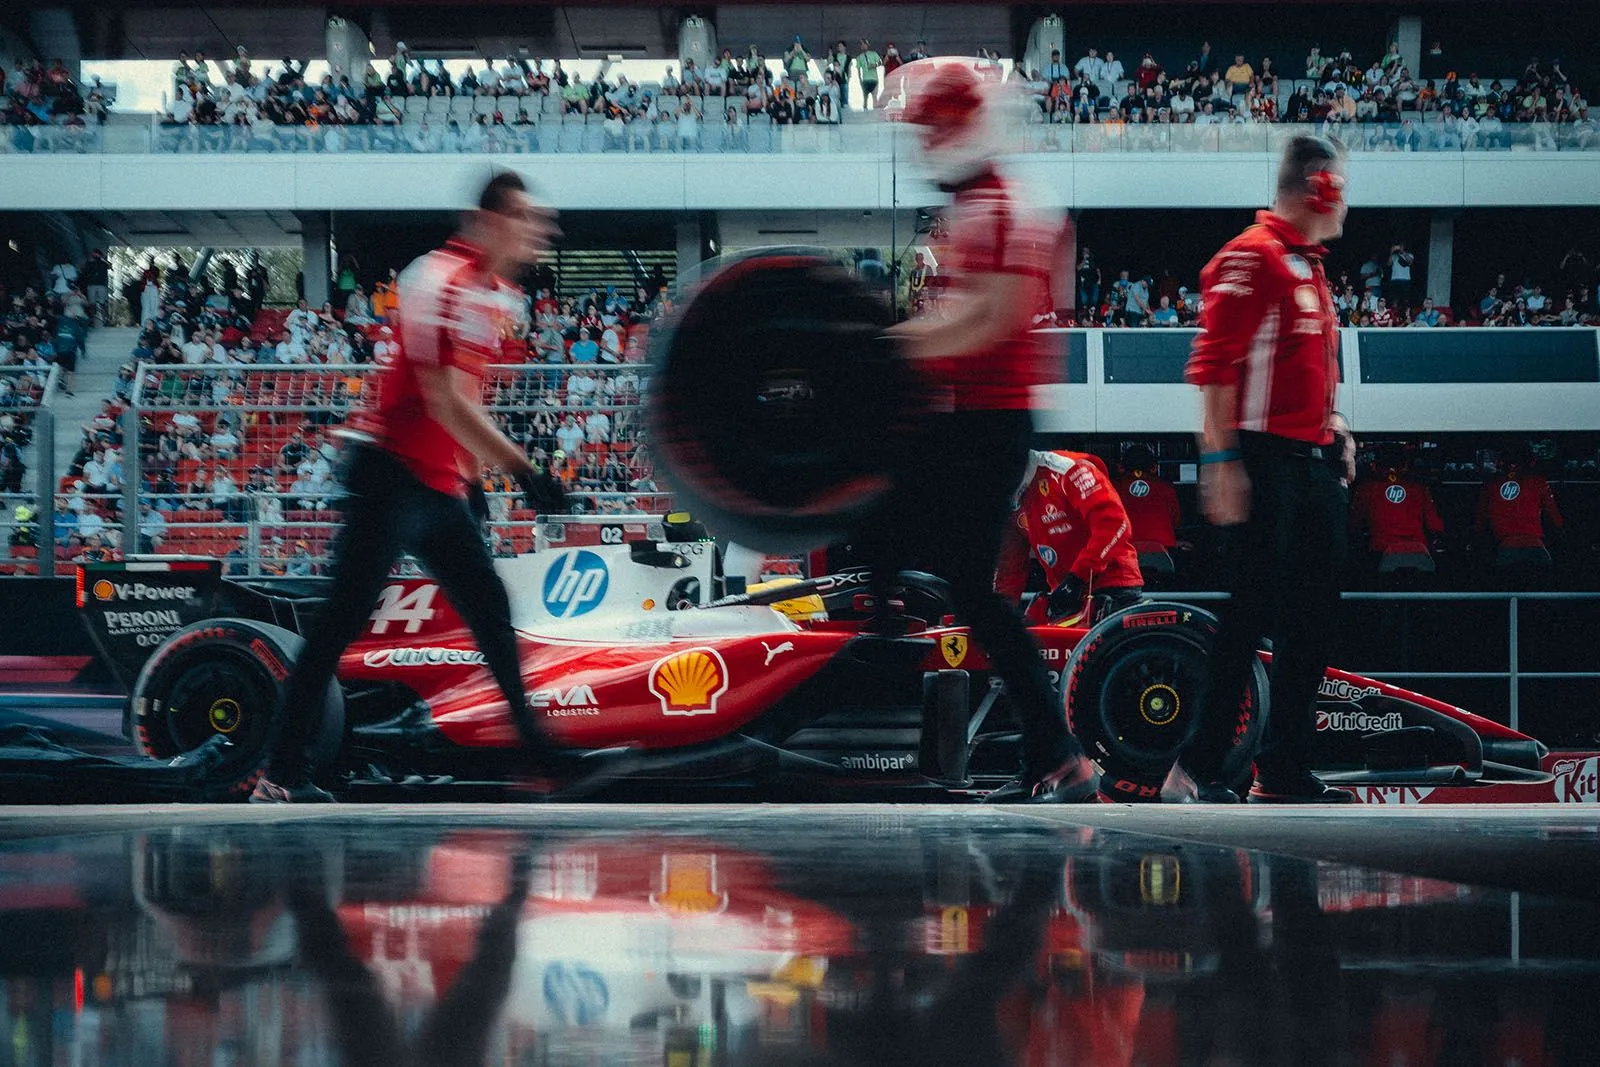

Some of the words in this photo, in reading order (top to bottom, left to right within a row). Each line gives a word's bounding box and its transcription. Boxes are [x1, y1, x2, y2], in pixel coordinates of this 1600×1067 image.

[1131, 481, 1148, 496] hp
[1387, 486, 1404, 503] hp
[1502, 482, 1518, 499] hp
[601, 527, 623, 544] 02
[114, 583, 196, 601] V-Power
[546, 549, 607, 618] hp
[104, 610, 181, 628] PERONI
[136, 633, 167, 647] 0.0
[547, 708, 600, 716] LOGISTICS
[1330, 712, 1404, 731] UniCredit
[841, 753, 905, 772] ambipar
[1564, 761, 1600, 802] Kit
